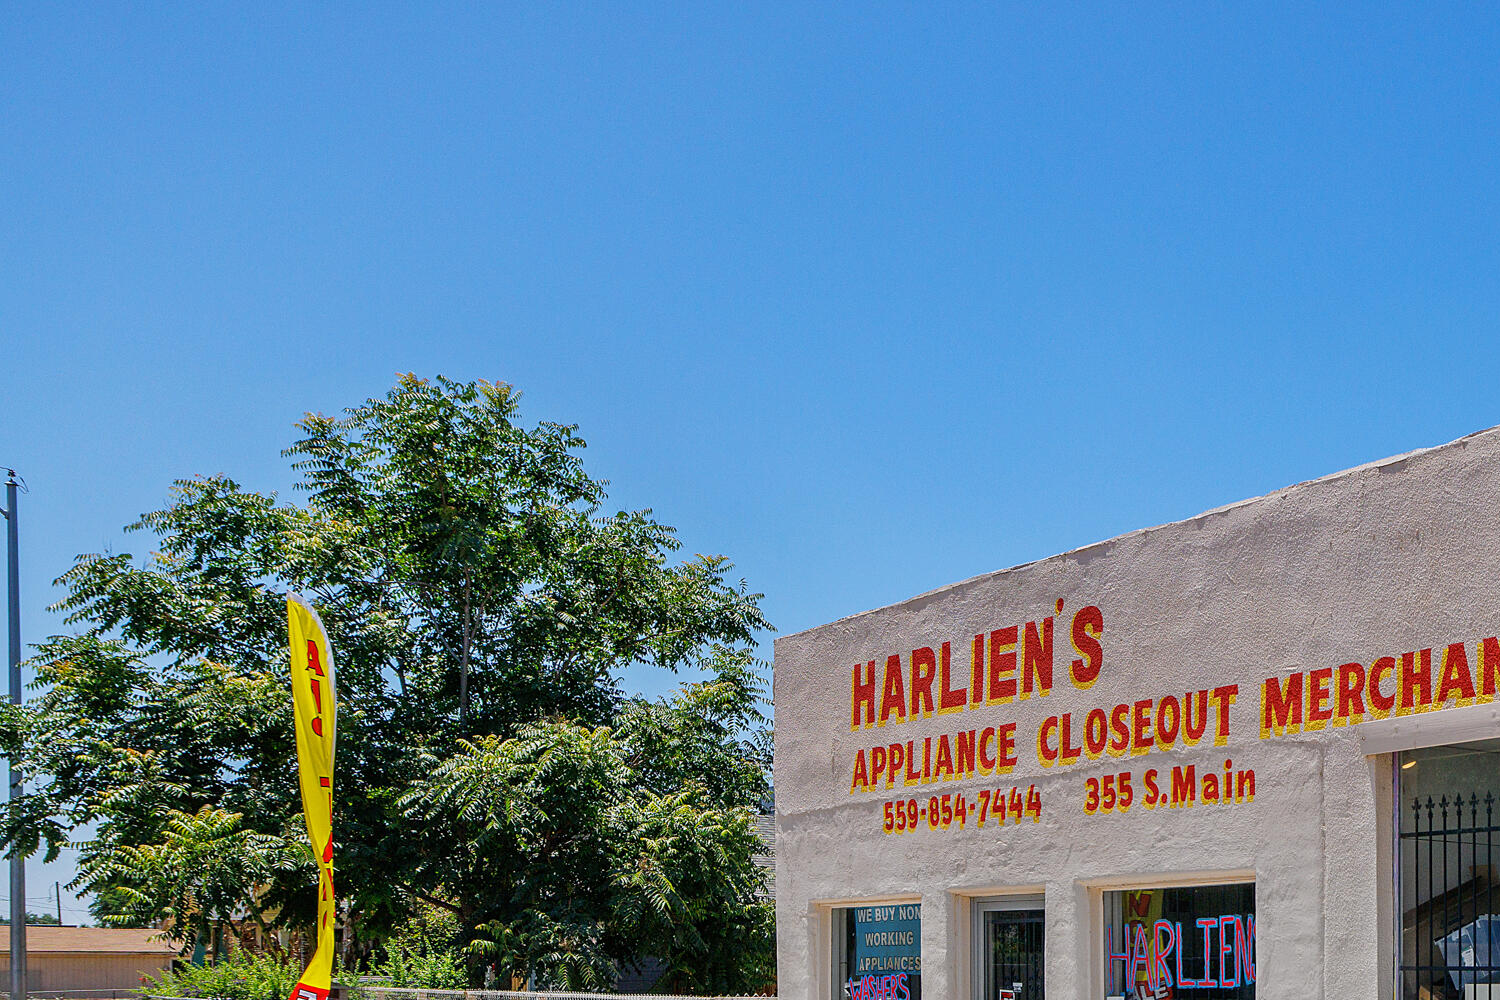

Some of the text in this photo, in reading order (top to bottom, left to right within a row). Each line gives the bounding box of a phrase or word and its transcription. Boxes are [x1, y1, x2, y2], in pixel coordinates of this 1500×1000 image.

[850, 598, 1105, 732] HARLIEN'S
[849, 722, 1018, 795] APPLIANCE
[1036, 684, 1239, 772] CLOSEOUT
[882, 783, 1042, 835] 559-854-7444
[1083, 771, 1134, 816] 355
[857, 908, 873, 924] WE
[875, 906, 896, 922] BUY
[865, 931, 914, 947] WORKING
[859, 957, 921, 972] APPLIANCES
[1107, 913, 1257, 995] HARLIEN
